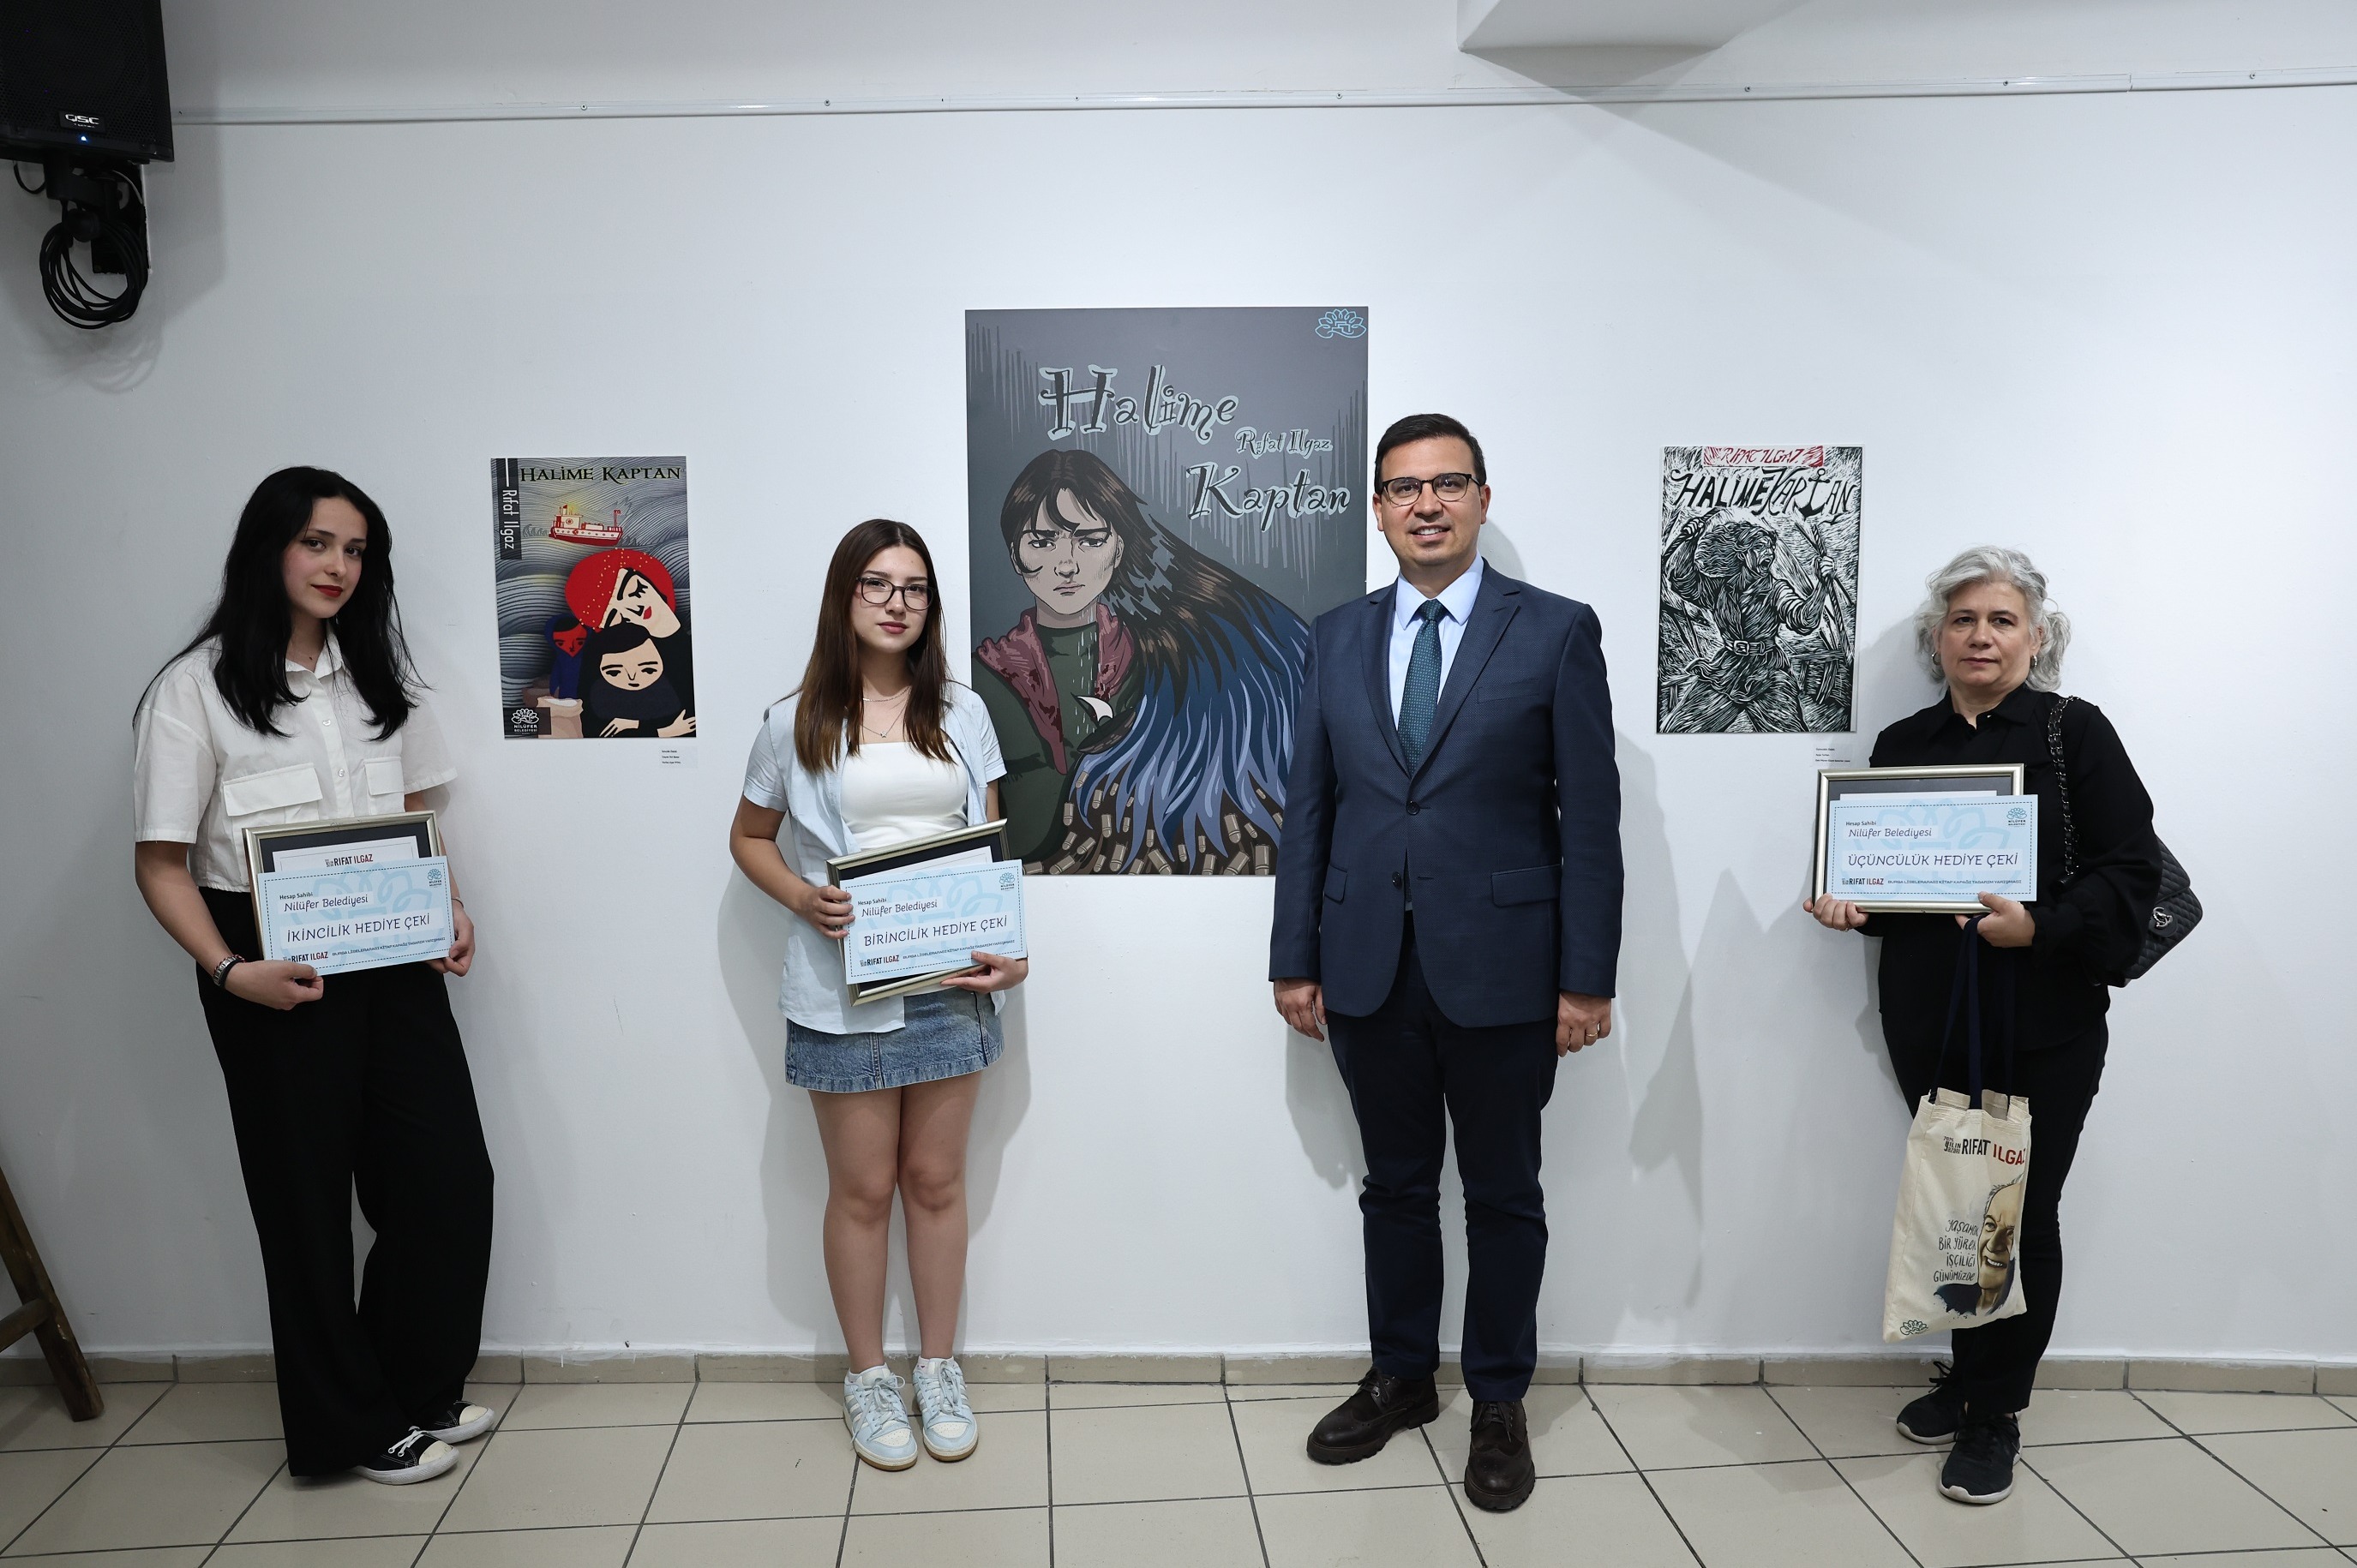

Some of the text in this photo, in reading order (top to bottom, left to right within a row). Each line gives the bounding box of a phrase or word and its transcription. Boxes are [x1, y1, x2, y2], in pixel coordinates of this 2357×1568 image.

[65, 114, 99, 124] QSC
[1039, 364, 1238, 444] Halime
[1286, 428, 1333, 459] Ilgaz
[520, 466, 681, 485] HALİME KAPTAN
[1186, 462, 1351, 532] Kaptan
[501, 521, 520, 549] Ilgaz
[1849, 828, 1932, 839] Nilüfer Belediyesi
[334, 857, 352, 866] RIFAT
[353, 853, 374, 864] ILGAZ
[1848, 853, 2018, 868] ÜÇÜNCÜLÜK HEDİYE ÇEKİ
[284, 895, 369, 912] Nilüfer Belediyesi
[861, 900, 938, 917] Nilüfer Belediyesi
[287, 913, 429, 943] İKİNCİLİK HEDİYE ÇEKİ
[864, 915, 1007, 946] BİRİNCİLİK HEDİYE ÇEKİ
[291, 954, 309, 962] RIFAT
[310, 951, 328, 961] ILGAZ
[867, 957, 882, 966] RIFAT
[884, 955, 899, 963] ILGAZ
[1962, 1139, 1991, 1155] RIFAT
[1939, 1235, 1951, 1250] BİR
